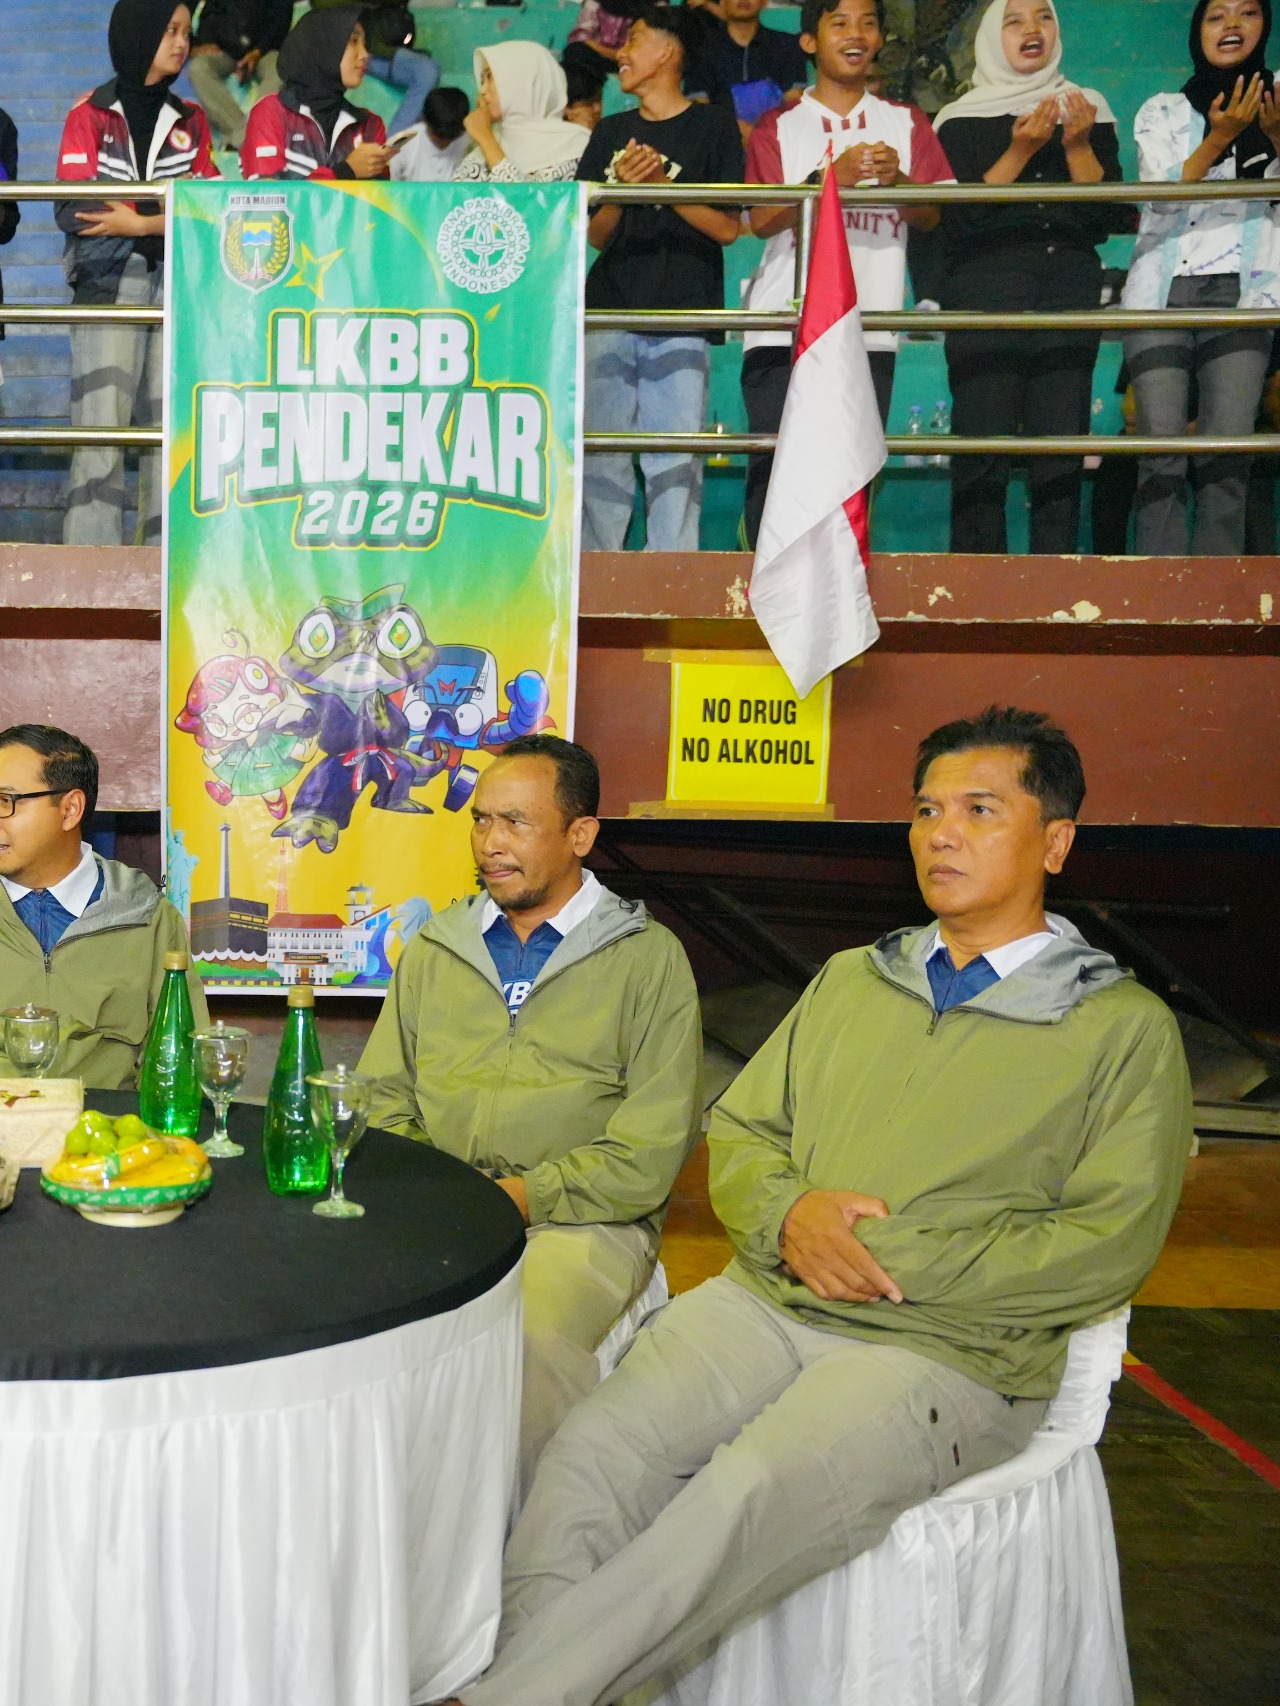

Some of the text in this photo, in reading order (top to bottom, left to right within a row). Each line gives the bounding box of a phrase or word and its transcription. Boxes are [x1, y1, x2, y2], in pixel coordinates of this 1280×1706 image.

[230, 196, 286, 205] KOTA MADIUN
[439, 200, 528, 251] PURNA PASKIBRAKA
[846, 211, 901, 238] NITY
[444, 264, 521, 291] INDONESIA
[276, 318, 470, 386] LKBB
[200, 391, 541, 504] PENDEKAR
[301, 490, 438, 535] 2026
[702, 698, 797, 725] NO DRUG
[681, 737, 815, 765] NO ALKOHOL
